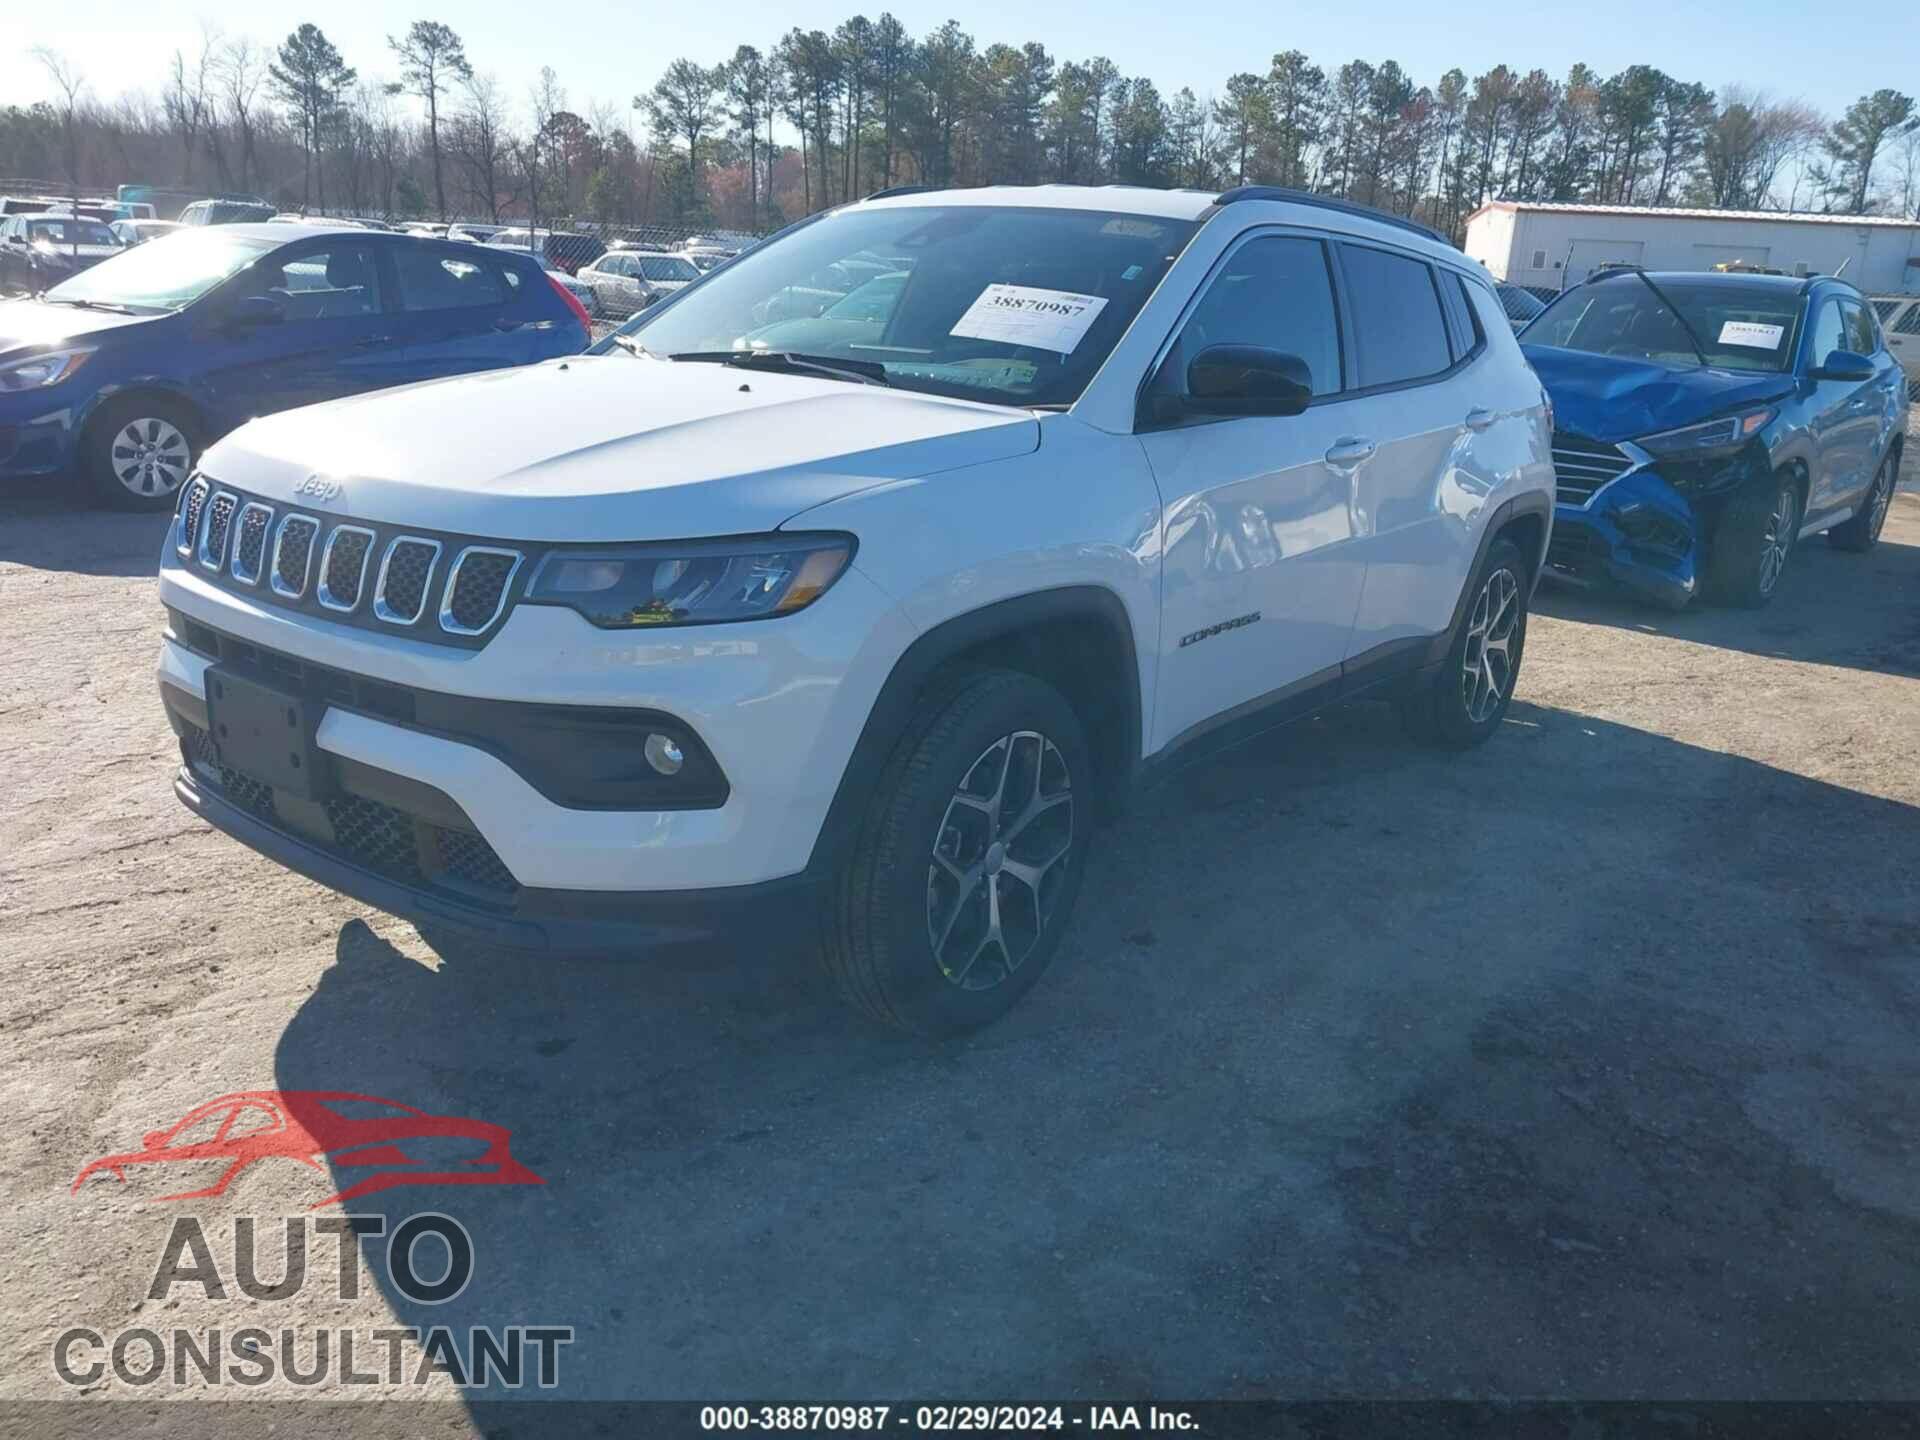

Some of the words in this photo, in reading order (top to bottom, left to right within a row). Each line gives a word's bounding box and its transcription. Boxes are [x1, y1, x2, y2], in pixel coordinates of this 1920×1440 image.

[987, 296, 1085, 317] 38870987
[294, 473, 342, 504] Jeep
[1179, 610, 1262, 648] COMPASS
